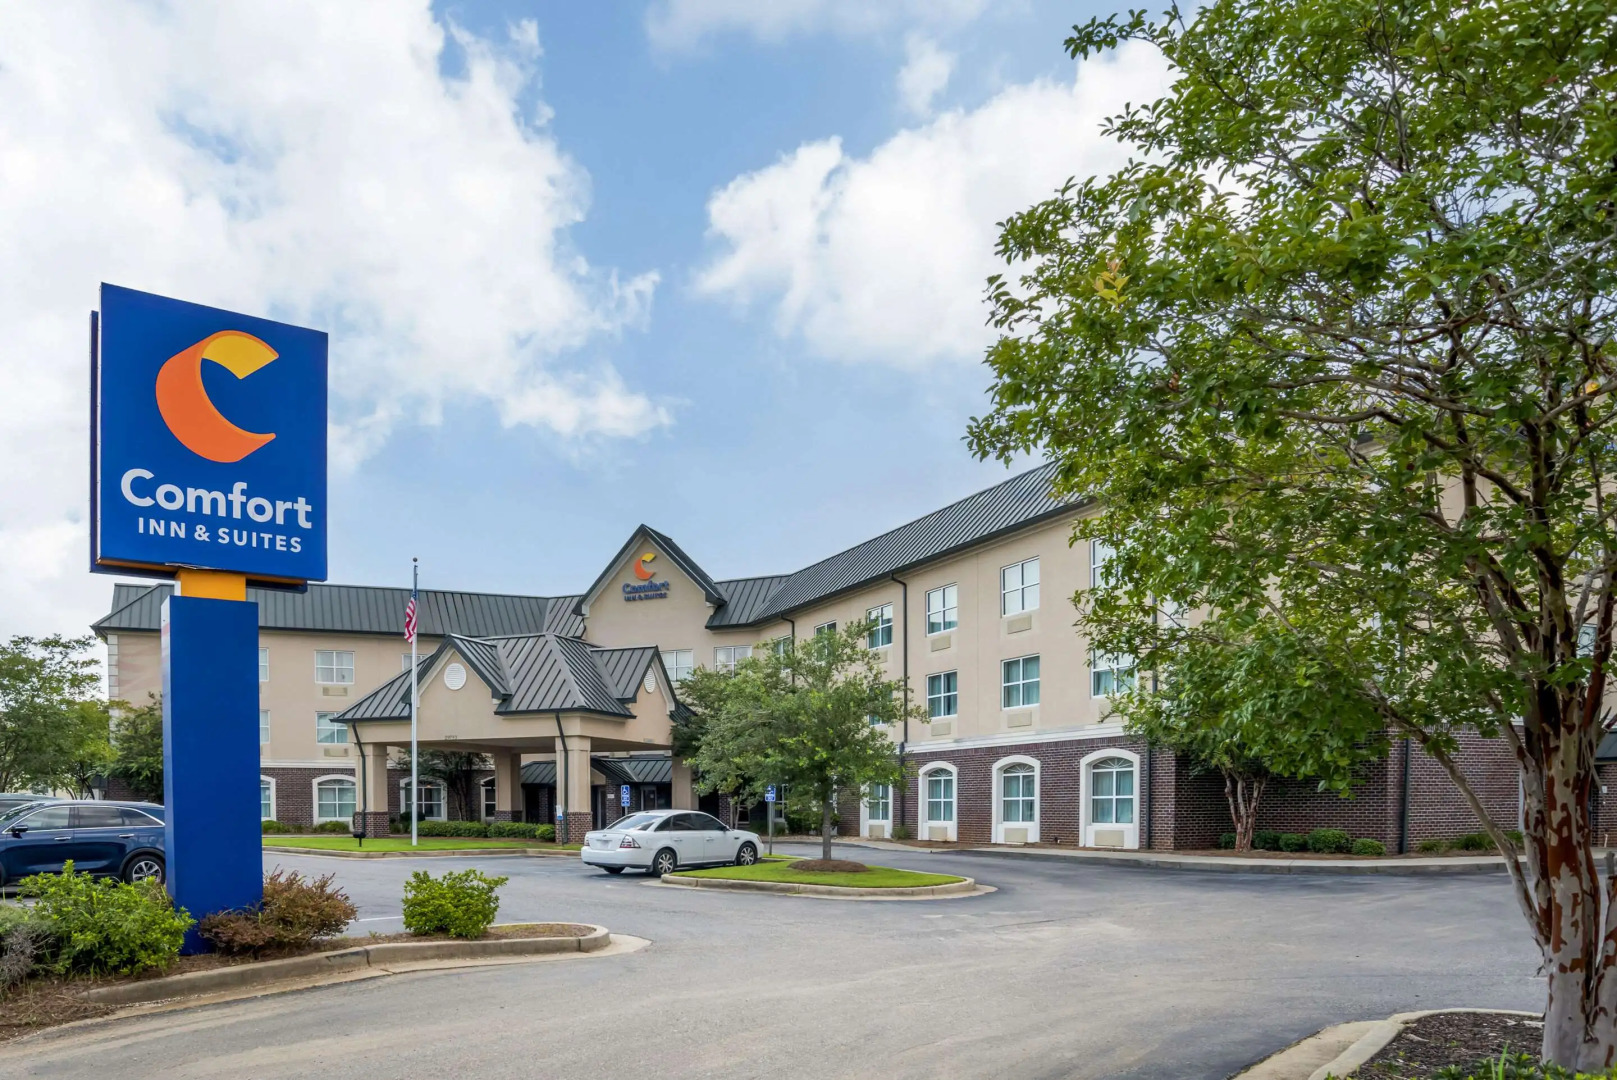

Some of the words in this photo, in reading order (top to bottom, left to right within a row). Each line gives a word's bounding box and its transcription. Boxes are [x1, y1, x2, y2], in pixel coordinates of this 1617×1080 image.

[120, 468, 312, 529] Comfort
[138, 517, 186, 539] INN
[194, 525, 210, 542] &
[218, 527, 302, 553] SUITES
